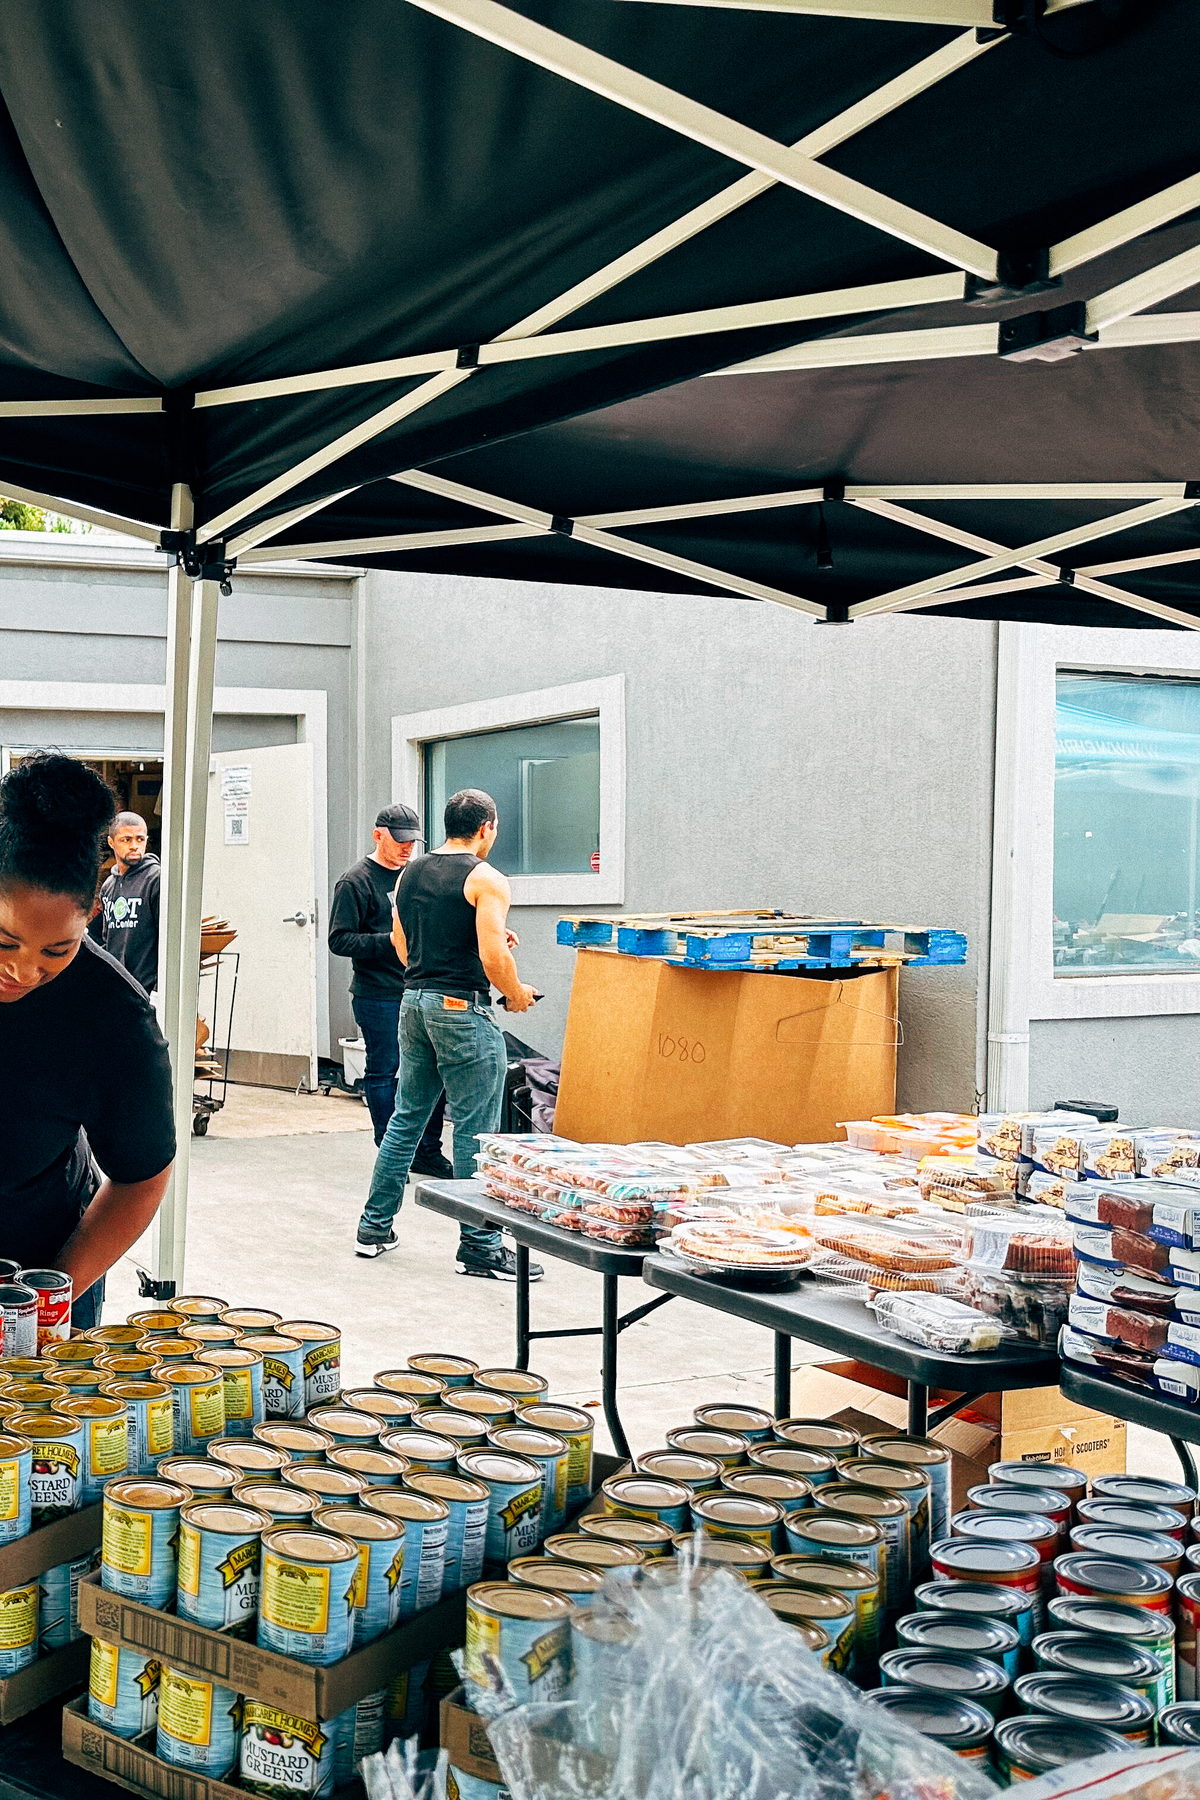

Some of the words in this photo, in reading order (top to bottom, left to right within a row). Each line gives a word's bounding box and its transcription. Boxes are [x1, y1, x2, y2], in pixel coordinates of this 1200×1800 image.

[659, 1033, 706, 1063] 1080
[280, 1713, 317, 1738] HOLMES
[245, 1737, 309, 1769] MUSTARD
[246, 1754, 303, 1783] GREENS
